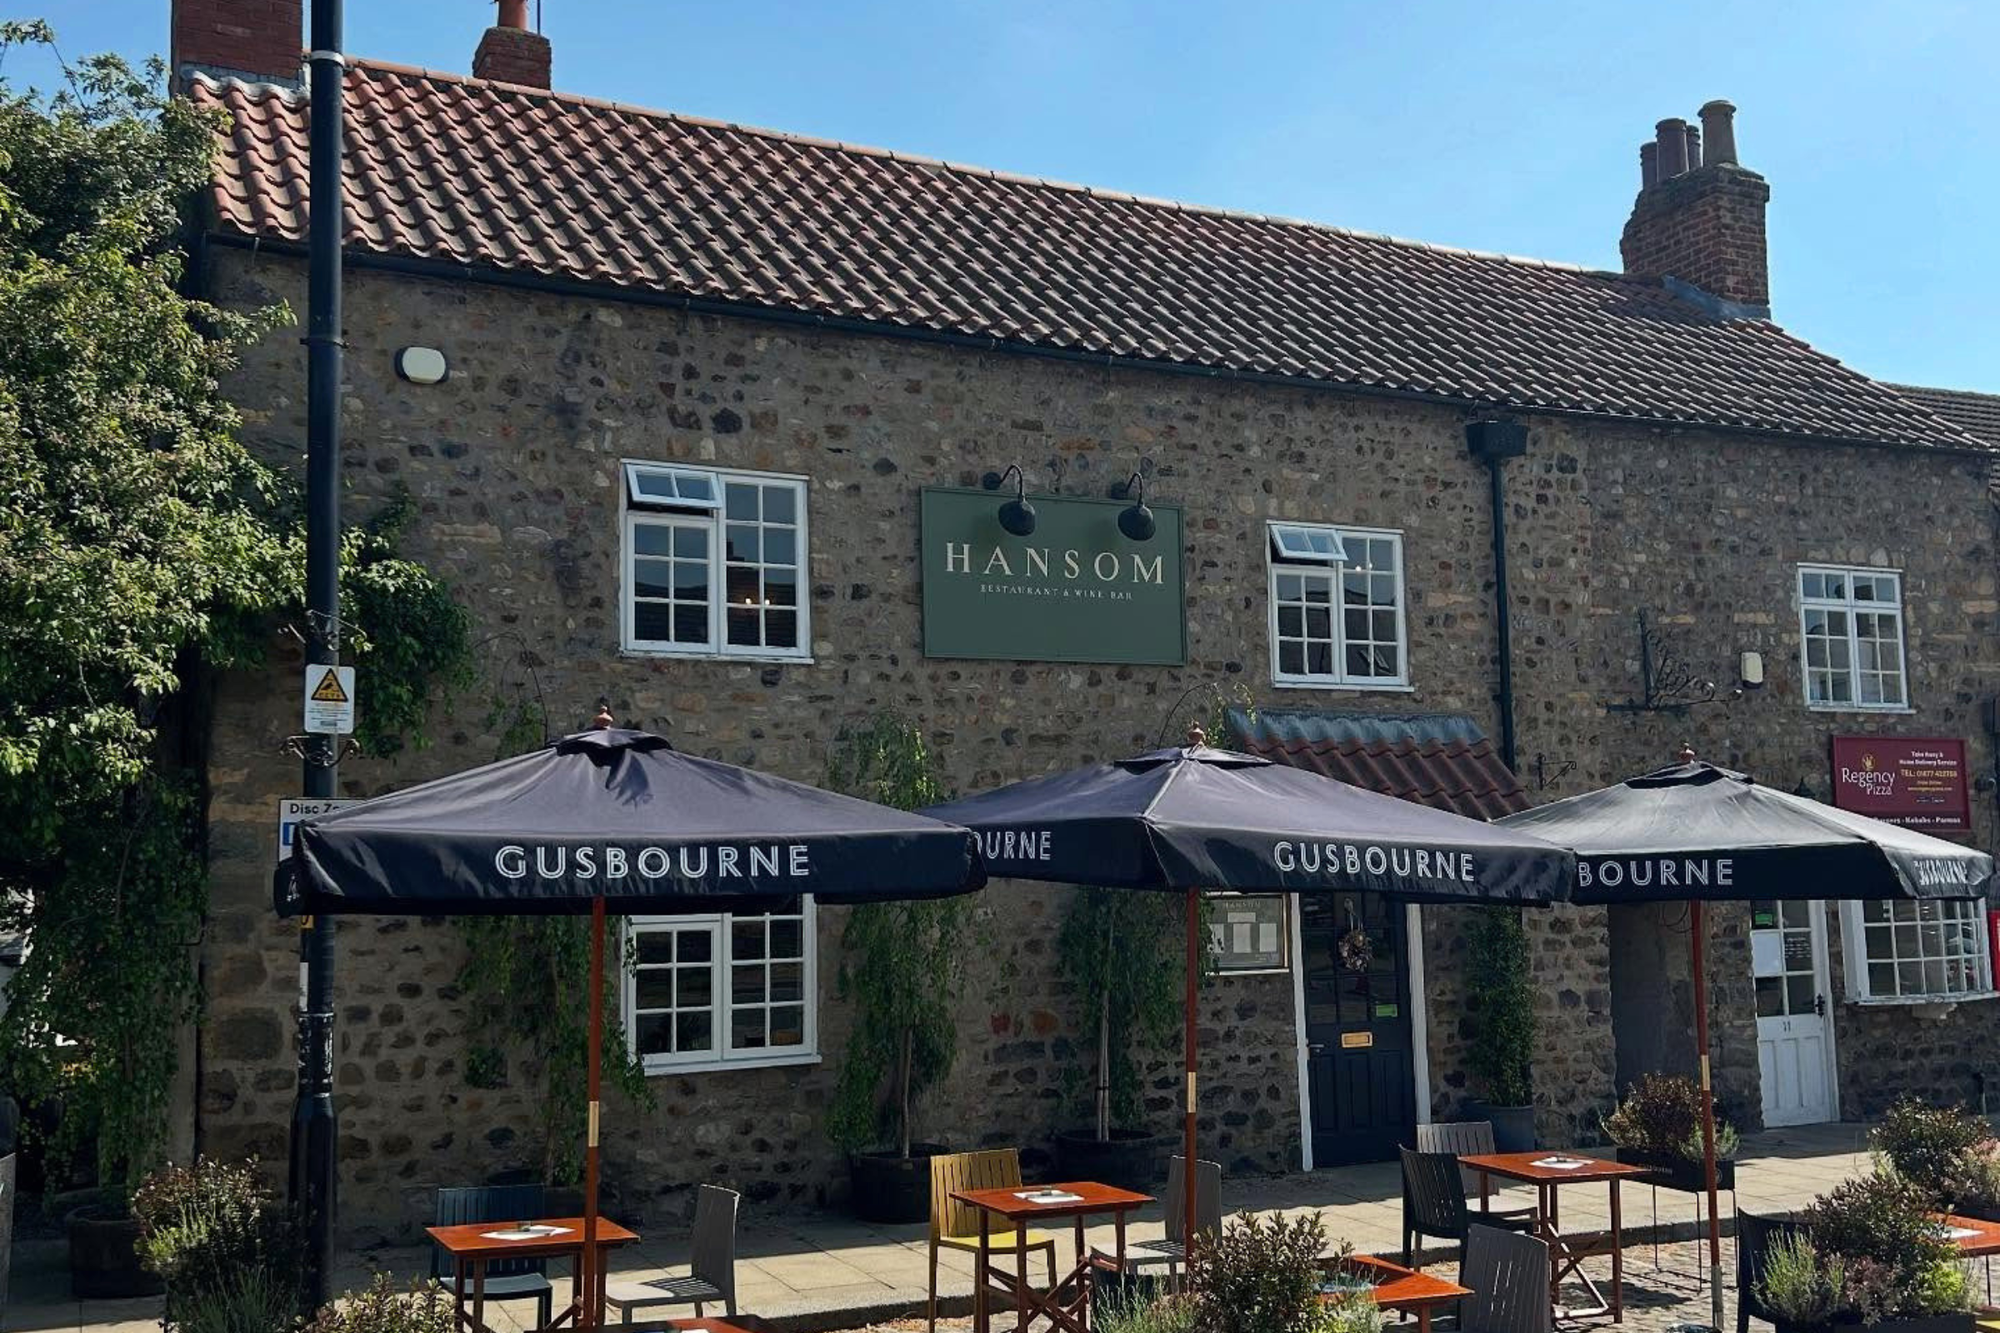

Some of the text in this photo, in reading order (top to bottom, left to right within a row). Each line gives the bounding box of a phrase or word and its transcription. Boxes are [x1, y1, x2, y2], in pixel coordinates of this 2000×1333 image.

[946, 542, 1164, 585] HANSOM
[980, 584, 1059, 597] RESTAURANT
[1074, 589, 1103, 598] WINE
[1110, 592, 1132, 600] BAR
[1841, 767, 1896, 788] Regency
[1866, 783, 1893, 796] Pizza
[290, 803, 319, 814] Disc
[495, 845, 810, 879] GUSBOURNE
[1274, 841, 1475, 882] GUSBOURNE
[1578, 859, 1733, 887] BOURNE
